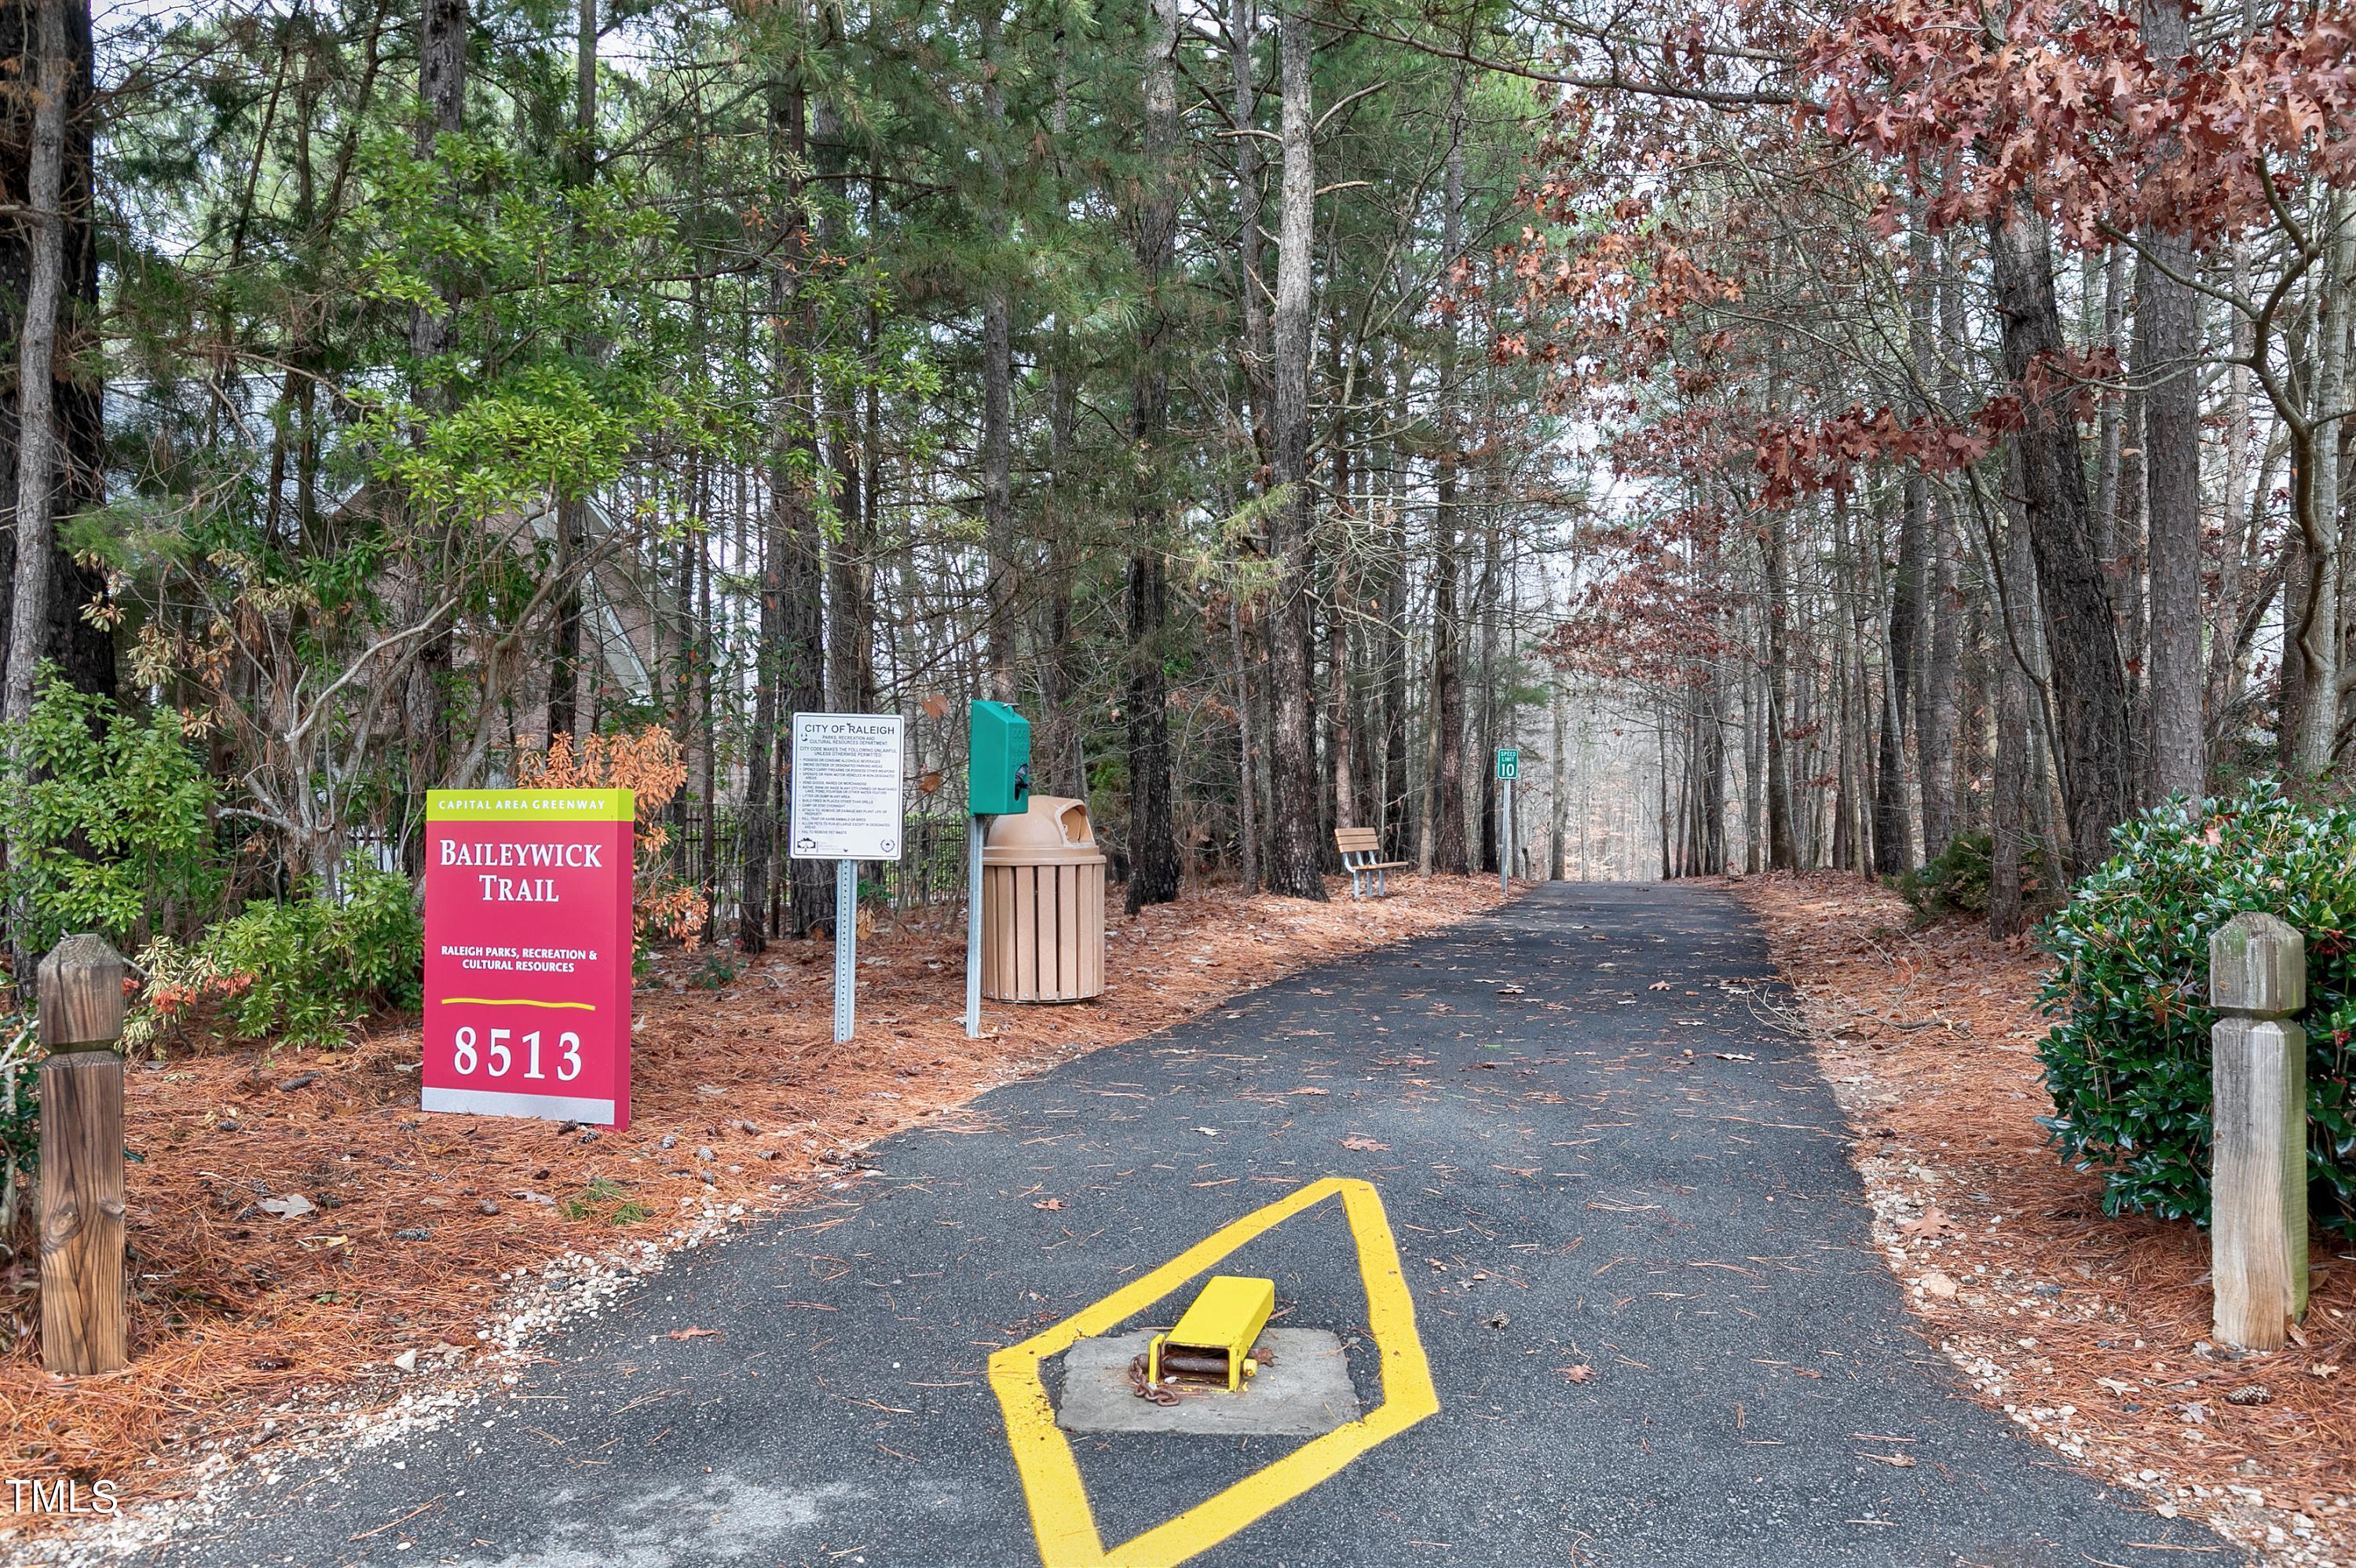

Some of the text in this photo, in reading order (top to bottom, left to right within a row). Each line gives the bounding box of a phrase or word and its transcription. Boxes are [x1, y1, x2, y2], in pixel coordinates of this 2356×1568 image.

[805, 724, 828, 733] CITY
[848, 726, 894, 735] RALEIGH
[1502, 763, 1514, 777] 10
[439, 800, 605, 810] CAPITAL AREA GREENWAY
[440, 839, 602, 868] BAILEYWICK
[479, 875, 559, 903] TRAIL
[441, 946, 598, 960] RALEIGH PARKS, RECREATION &
[463, 959, 575, 973] CULTURAL RESOURCES
[454, 1025, 582, 1082] 8513
